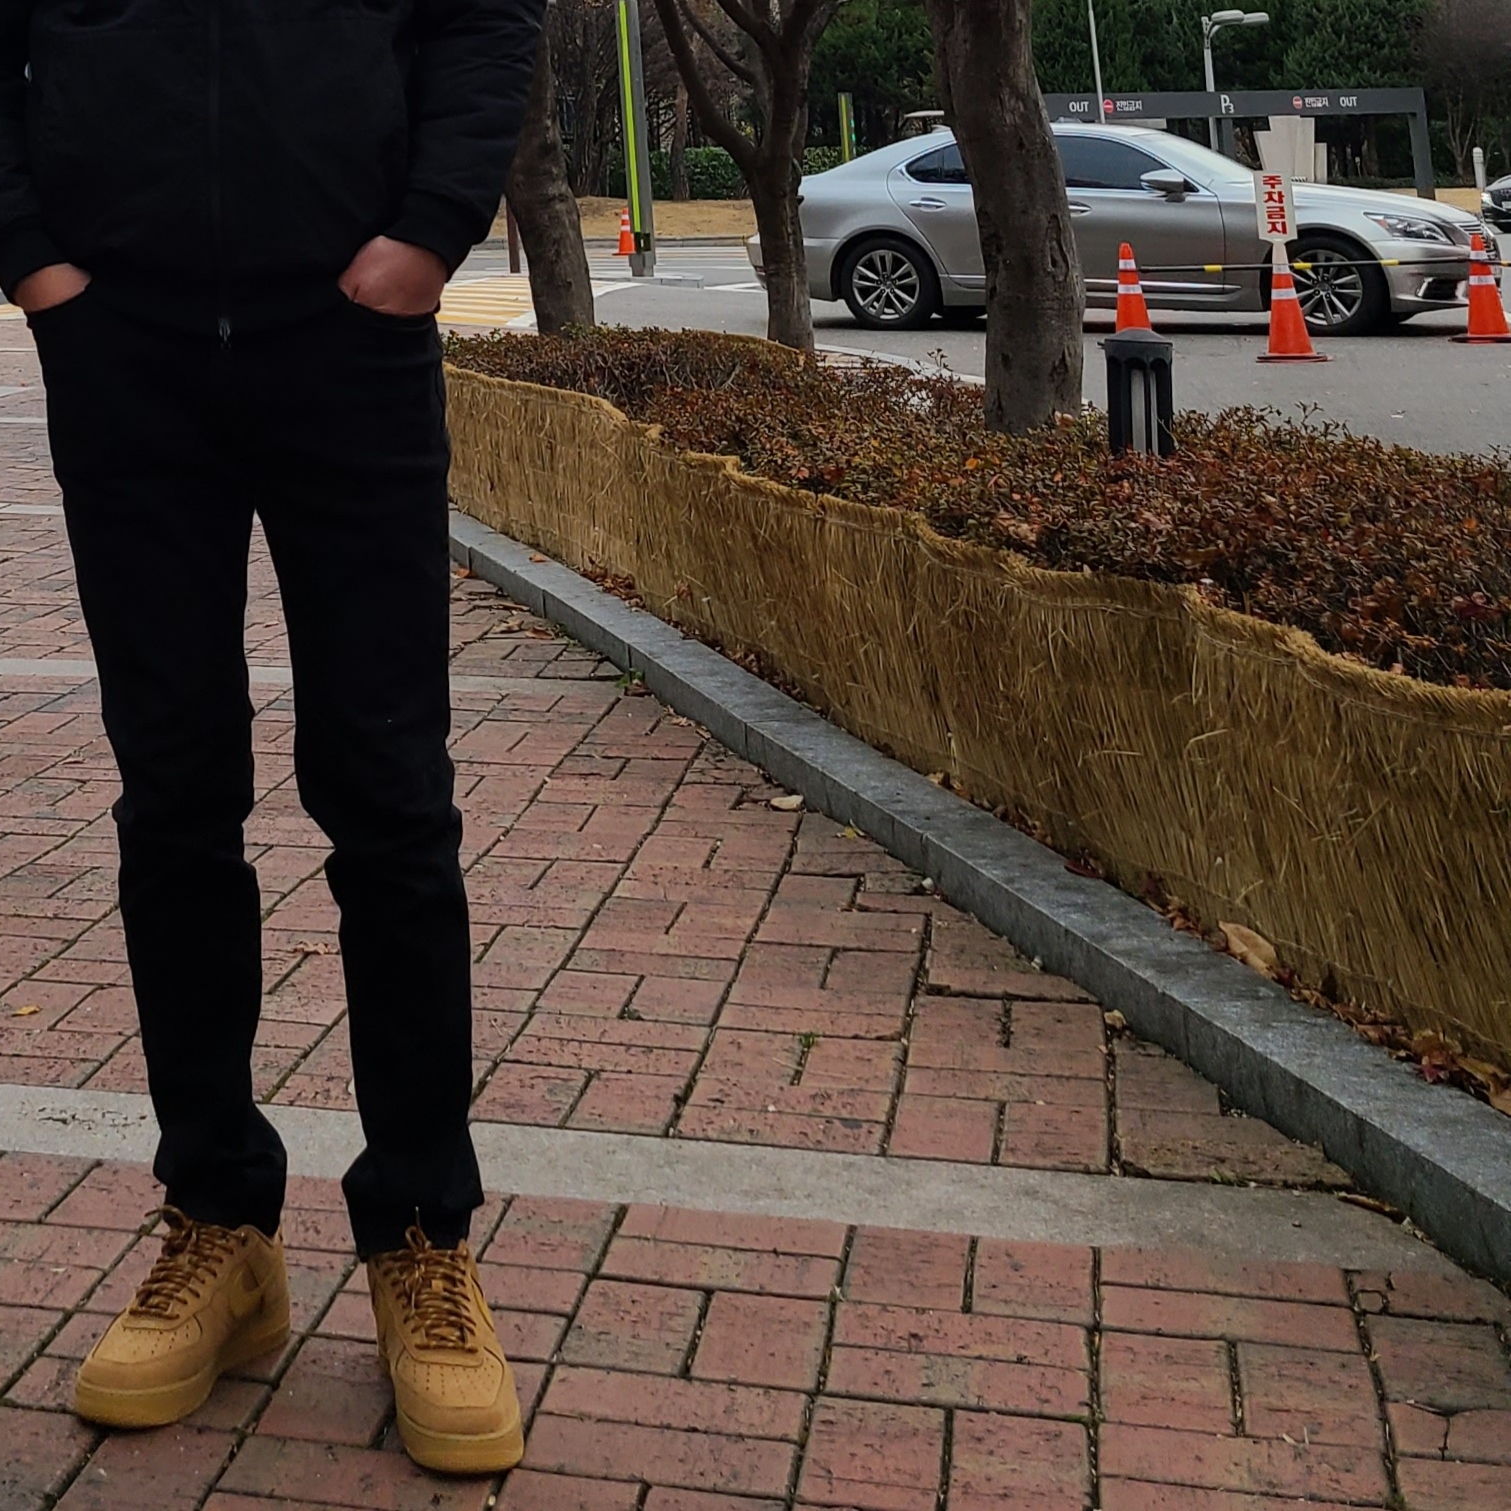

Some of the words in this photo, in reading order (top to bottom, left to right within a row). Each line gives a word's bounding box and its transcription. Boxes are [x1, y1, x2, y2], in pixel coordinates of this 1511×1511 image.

[1068, 101, 1089, 113] OUT
[1219, 93, 1235, 115] P3
[1339, 96, 1358, 107] OUT
